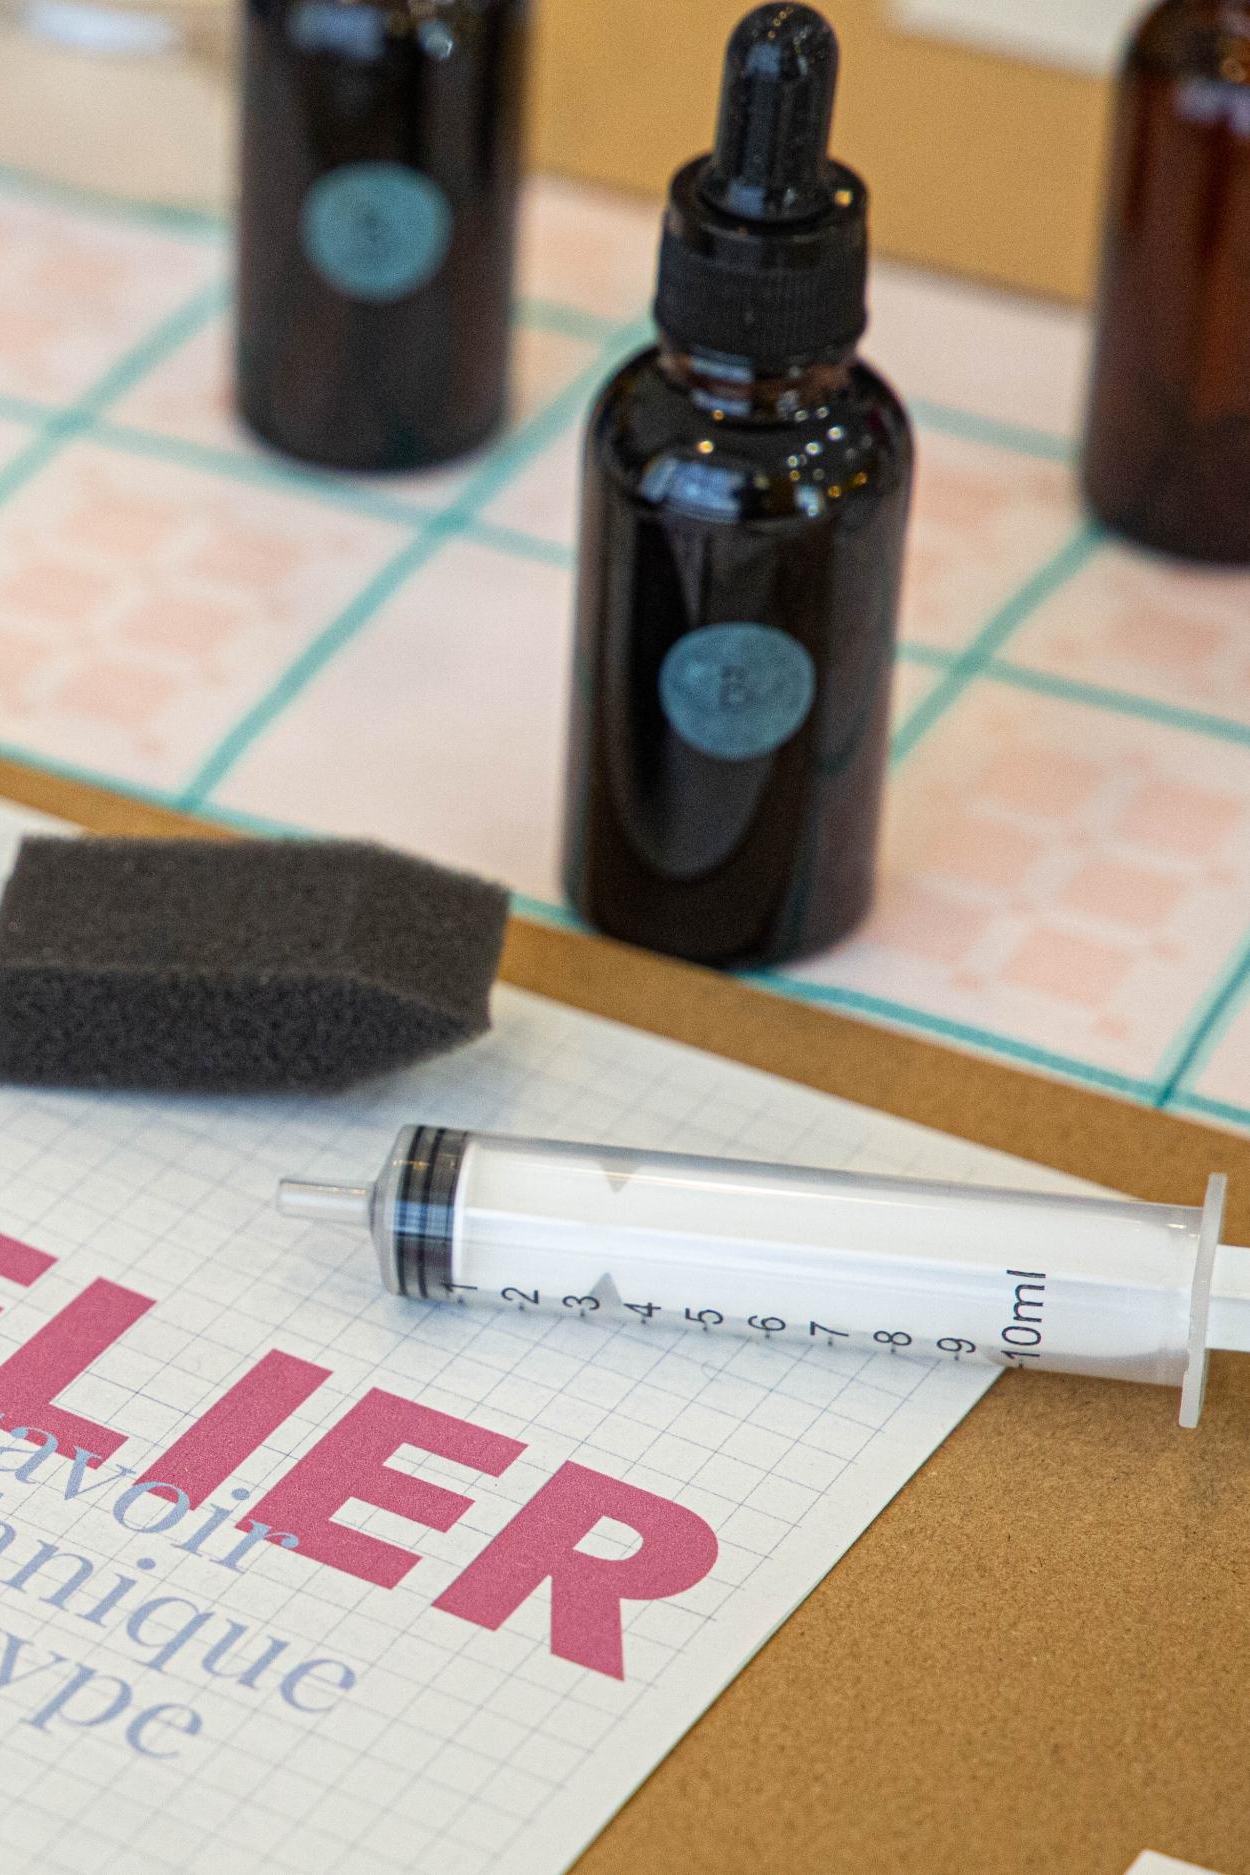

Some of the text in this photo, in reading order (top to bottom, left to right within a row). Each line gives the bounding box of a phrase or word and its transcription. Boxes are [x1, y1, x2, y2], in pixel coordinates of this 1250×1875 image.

[441, 1281, 479, 1293] 1
[500, 1286, 540, 1305] 2
[561, 1294, 601, 1311] 3
[623, 1301, 662, 1318] 4
[684, 1307, 724, 1326] 5
[1001, 1269, 1047, 1360] 10ml
[747, 1315, 787, 1333] 6
[809, 1320, 850, 1337] 7
[872, 1330, 913, 1347] 8
[936, 1337, 977, 1354] 9
